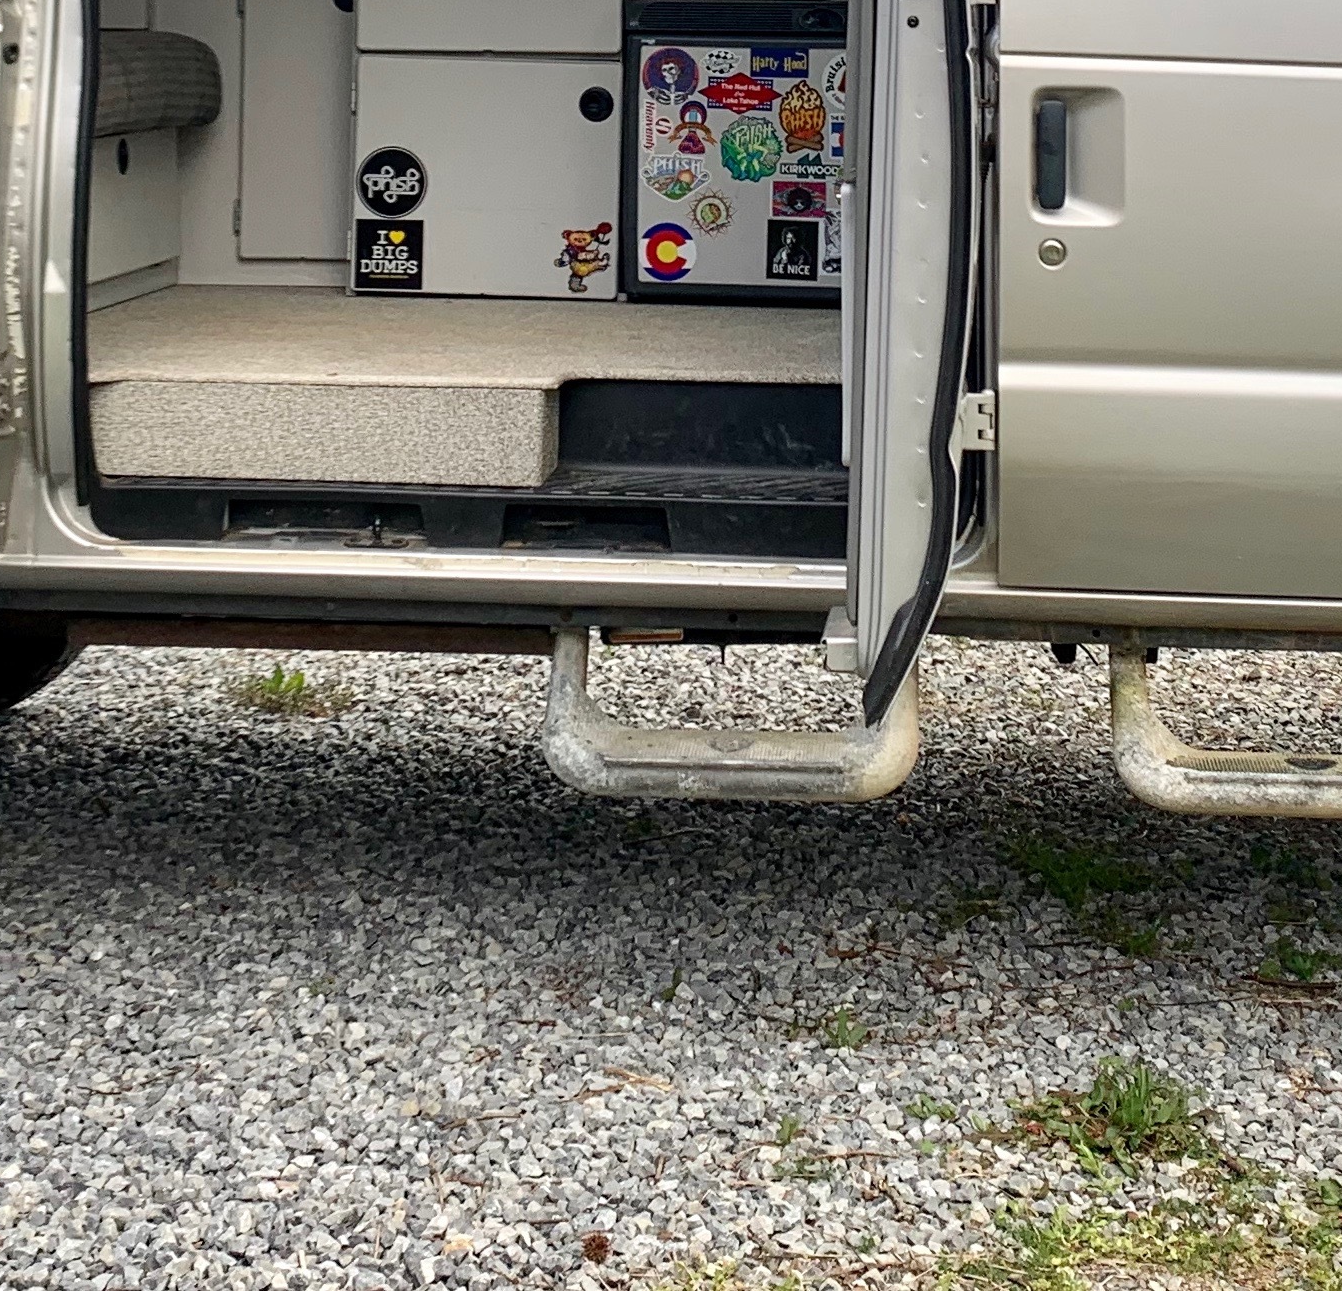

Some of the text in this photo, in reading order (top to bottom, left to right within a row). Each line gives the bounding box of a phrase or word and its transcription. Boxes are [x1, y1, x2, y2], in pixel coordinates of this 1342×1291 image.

[752, 55, 779, 72] Harry
[783, 52, 807, 72] Hood
[781, 110, 824, 131] PHISH
[781, 164, 839, 176] KIRKWOOD
[376, 230, 388, 245] I
[371, 245, 409, 259] BIG
[360, 259, 419, 275] DUMPS
[772, 263, 811, 276] BE NICE
